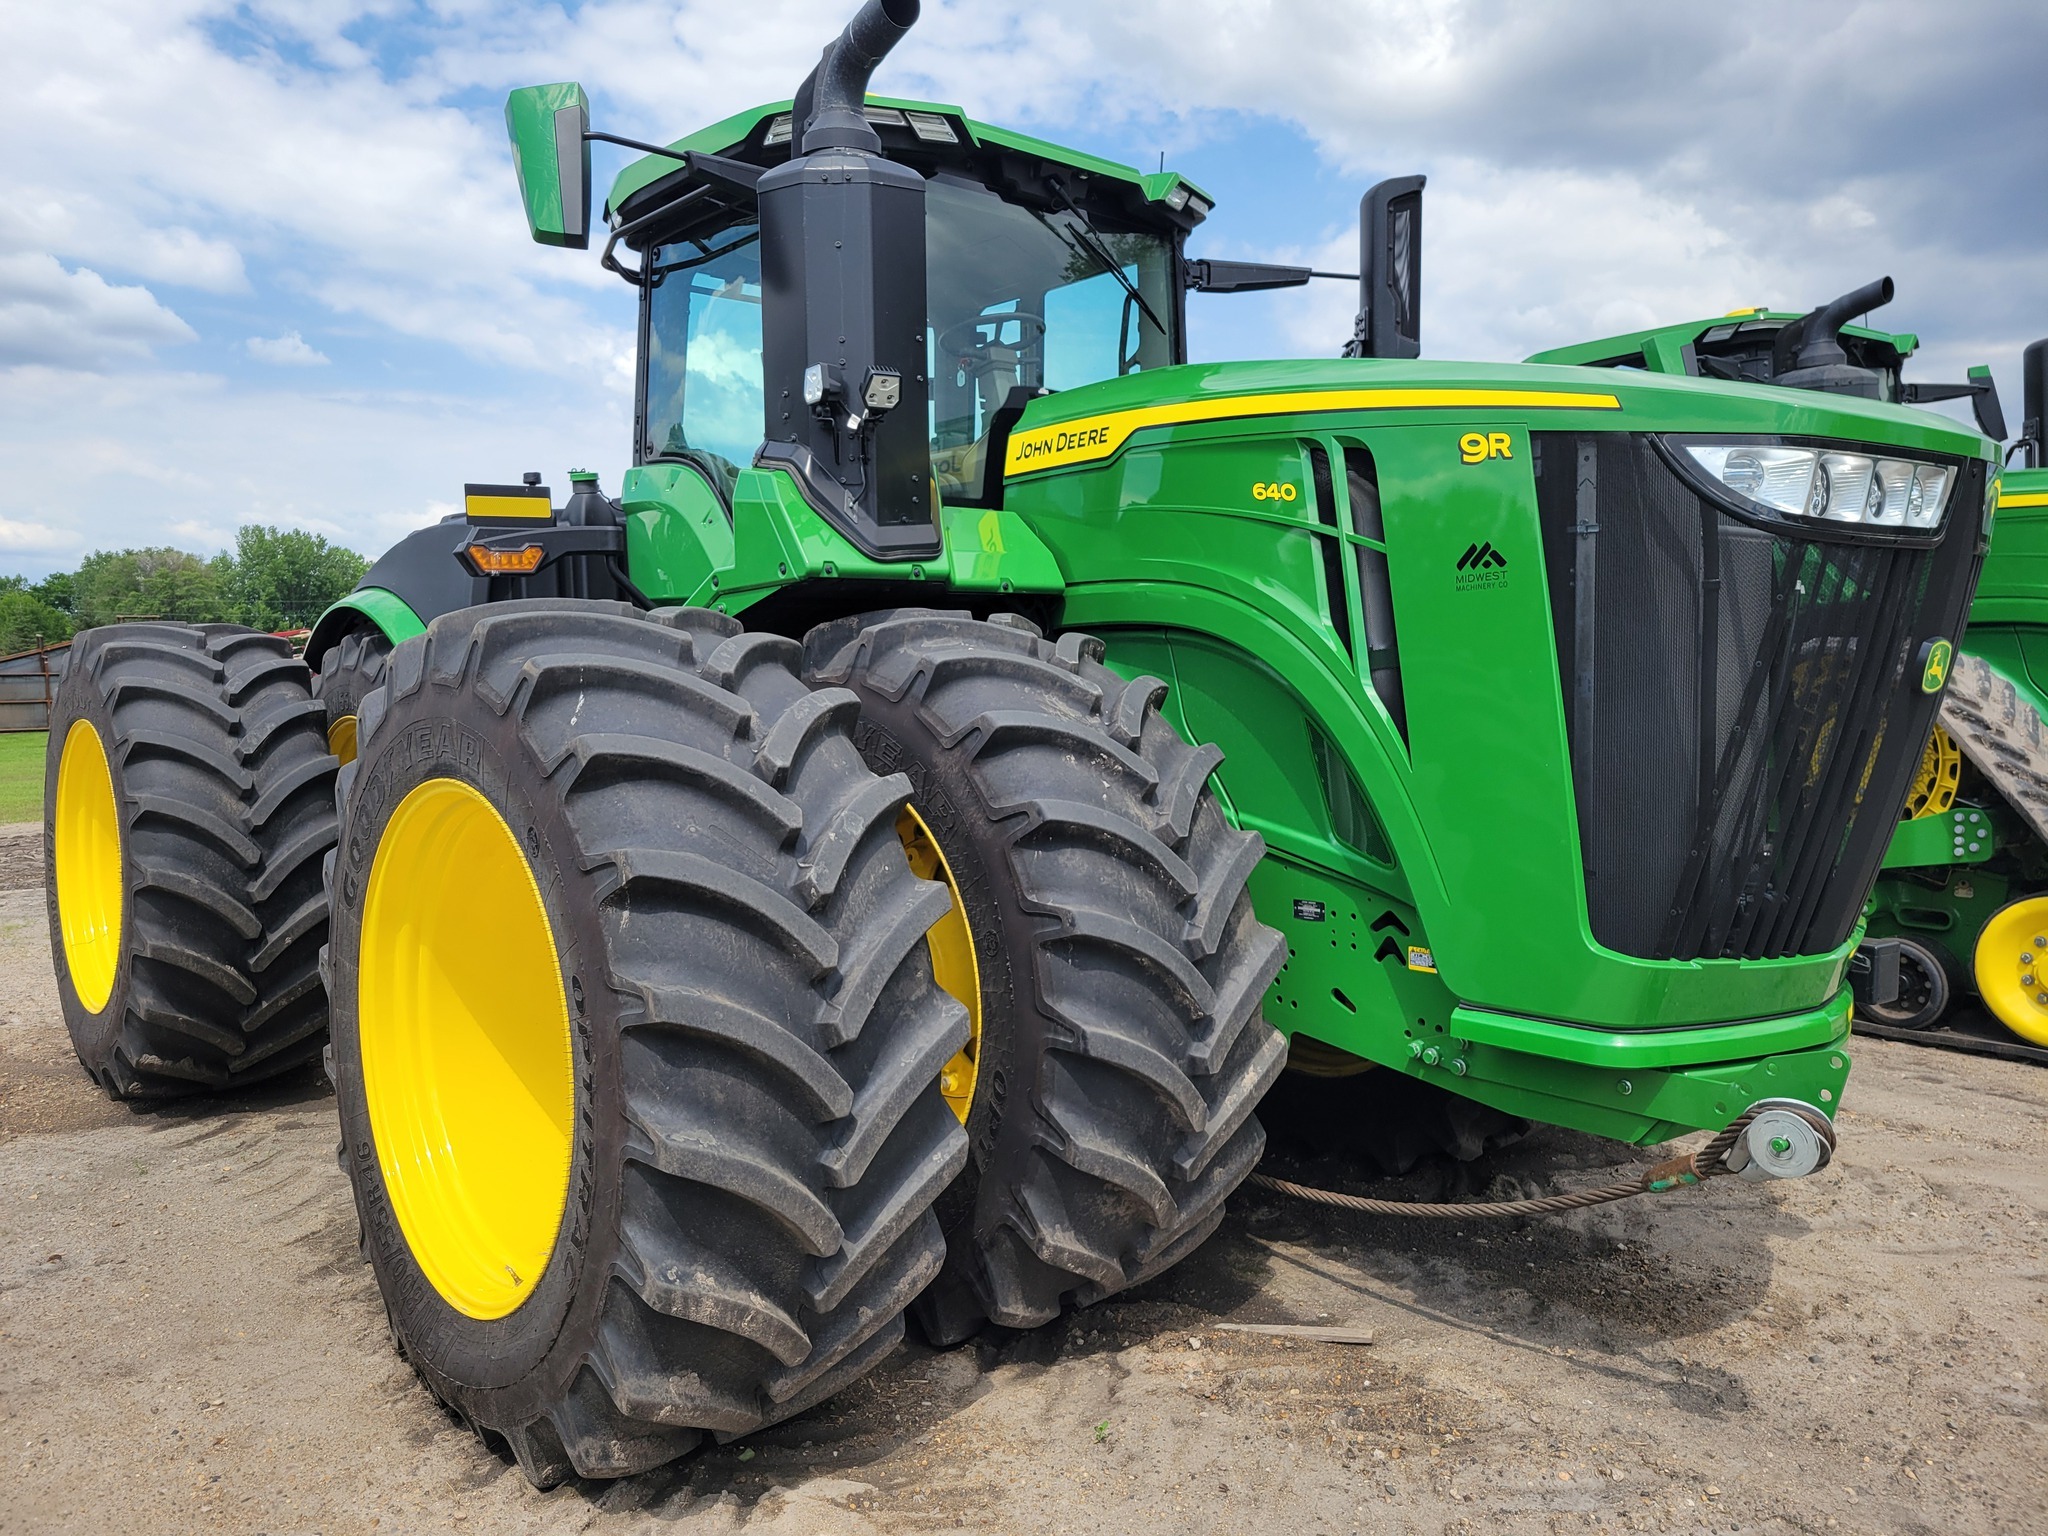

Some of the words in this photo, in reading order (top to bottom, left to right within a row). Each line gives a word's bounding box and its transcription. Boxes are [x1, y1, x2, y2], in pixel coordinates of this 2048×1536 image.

[1015, 438, 1054, 461] JOHN
[1055, 426, 1110, 453] DEERE
[1458, 432, 1513, 466] 9R
[1252, 481, 1297, 502] 640
[1456, 570, 1508, 584] MIDWEST
[1456, 582, 1495, 592] MACHINERY
[1498, 580, 1508, 589] CO
[343, 723, 482, 910] GOODYEAR
